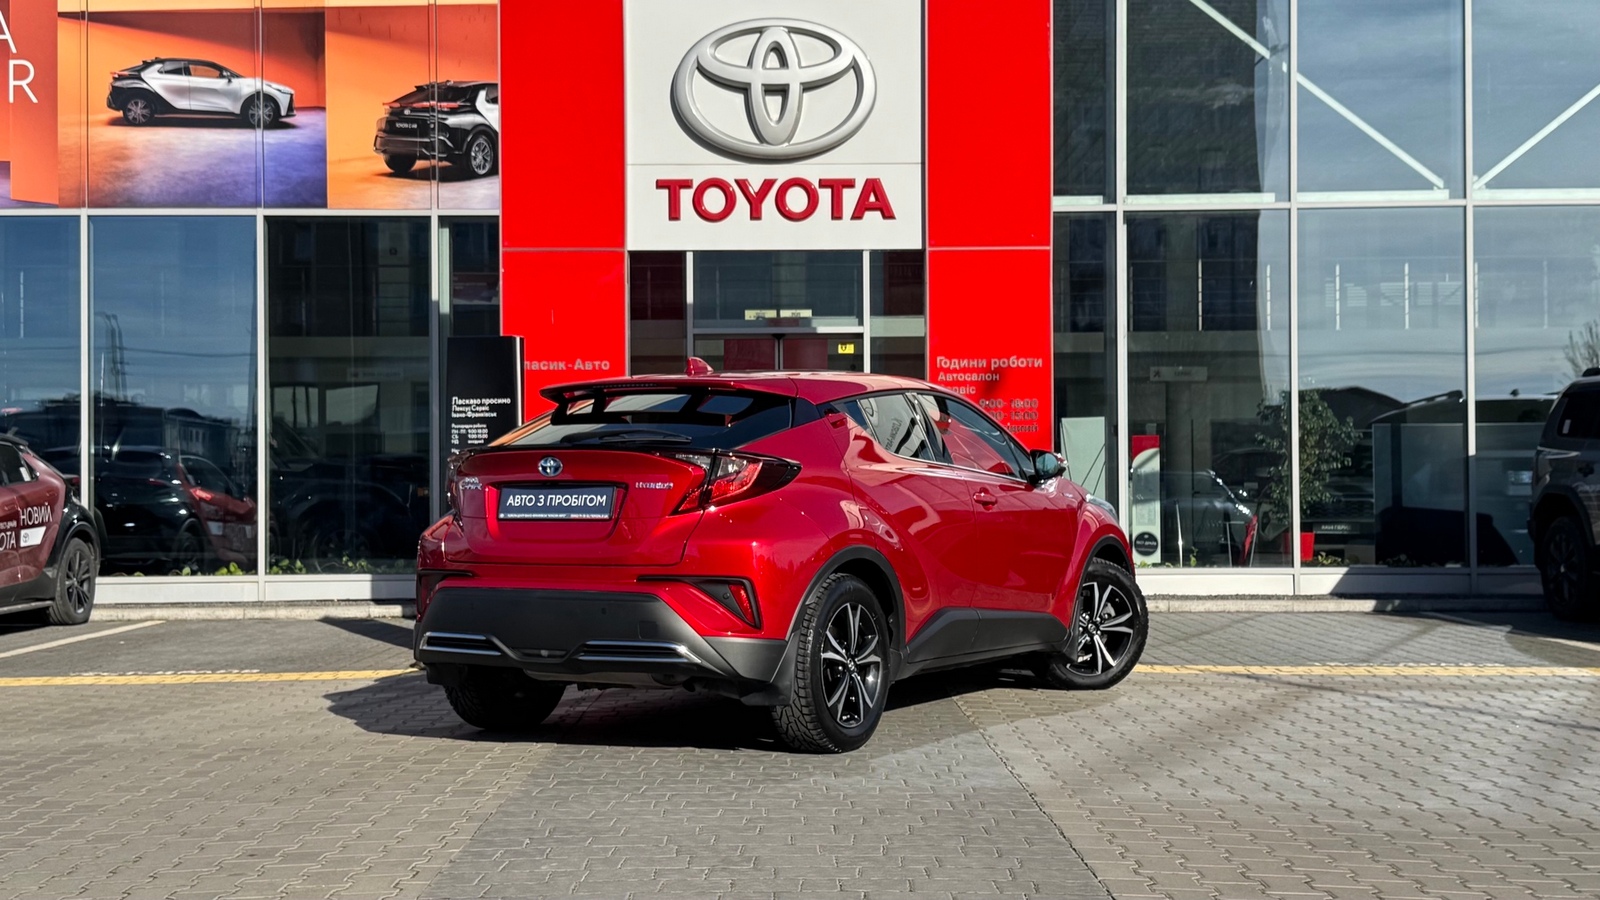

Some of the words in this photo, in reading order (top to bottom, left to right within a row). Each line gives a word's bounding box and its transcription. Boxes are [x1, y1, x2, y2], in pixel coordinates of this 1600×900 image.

[655, 177, 897, 223] TOYOTA
[524, 358, 610, 371] ласик-Авто
[936, 356, 987, 370] Години
[991, 355, 1043, 371] роботи
[938, 371, 1000, 382] Автосалон
[481, 398, 512, 406] просимо
[506, 494, 536, 507] АВТО
[546, 494, 607, 507] ПРОБІГОМ
[20, 501, 53, 526] НОВИЙ
